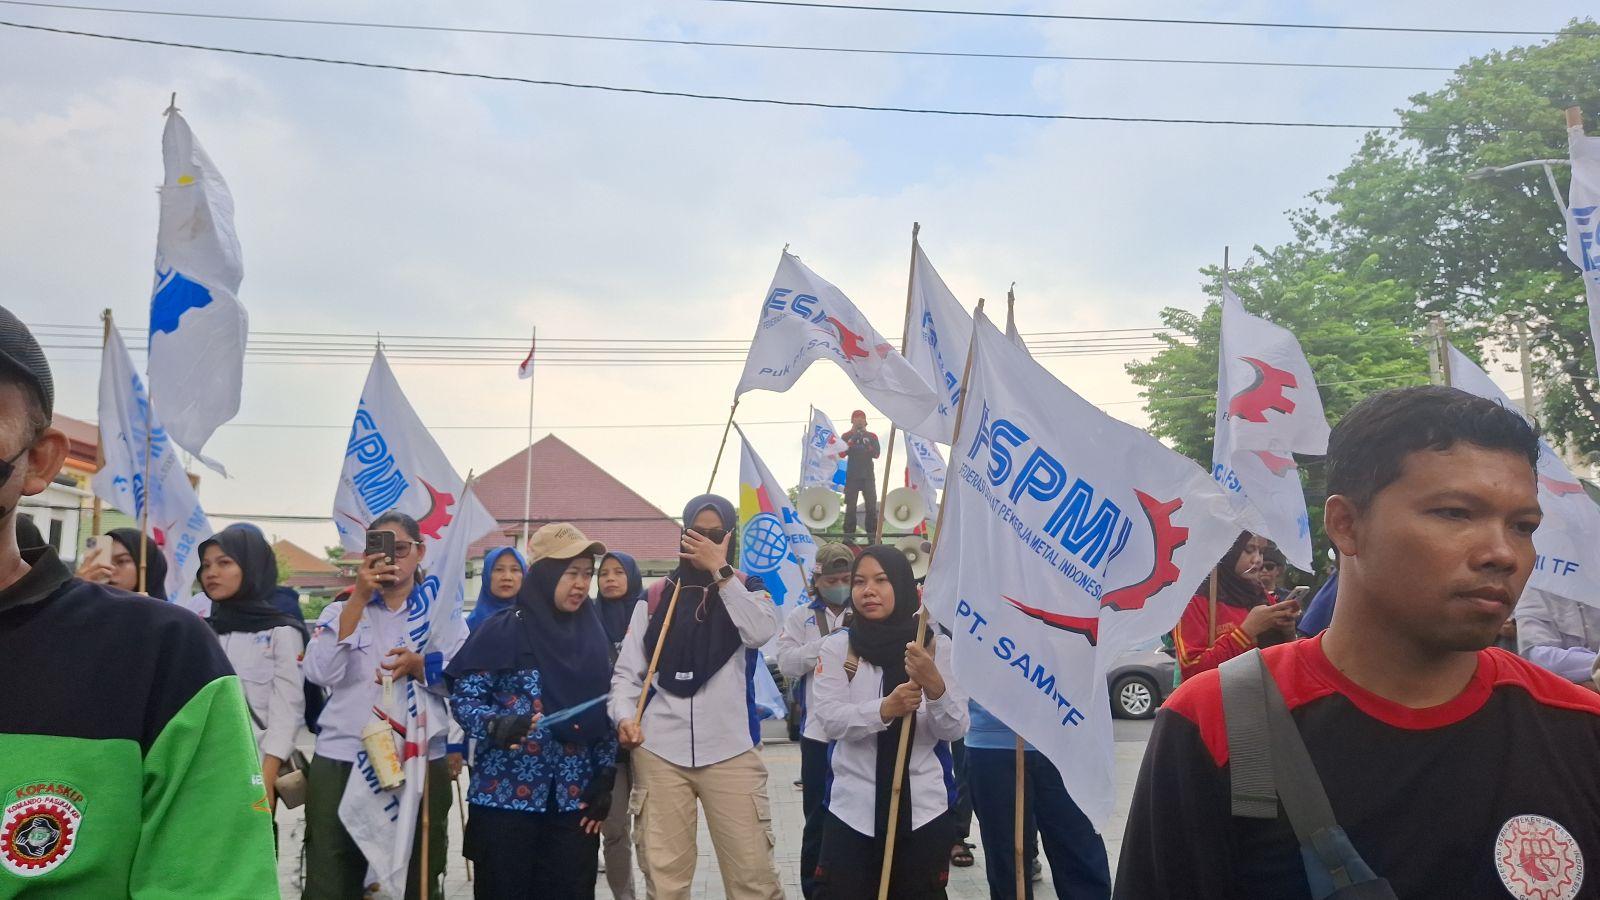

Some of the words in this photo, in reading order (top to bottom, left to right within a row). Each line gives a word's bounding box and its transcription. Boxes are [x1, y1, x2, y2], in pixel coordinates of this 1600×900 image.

[346, 398, 410, 515] SPMI
[997, 503, 1031, 544] PEKERJA
[1029, 535, 1060, 567] METAL
[1553, 558, 1580, 577] TF
[956, 599, 988, 642] PT.
[7, 797, 42, 814] KOMANDO
